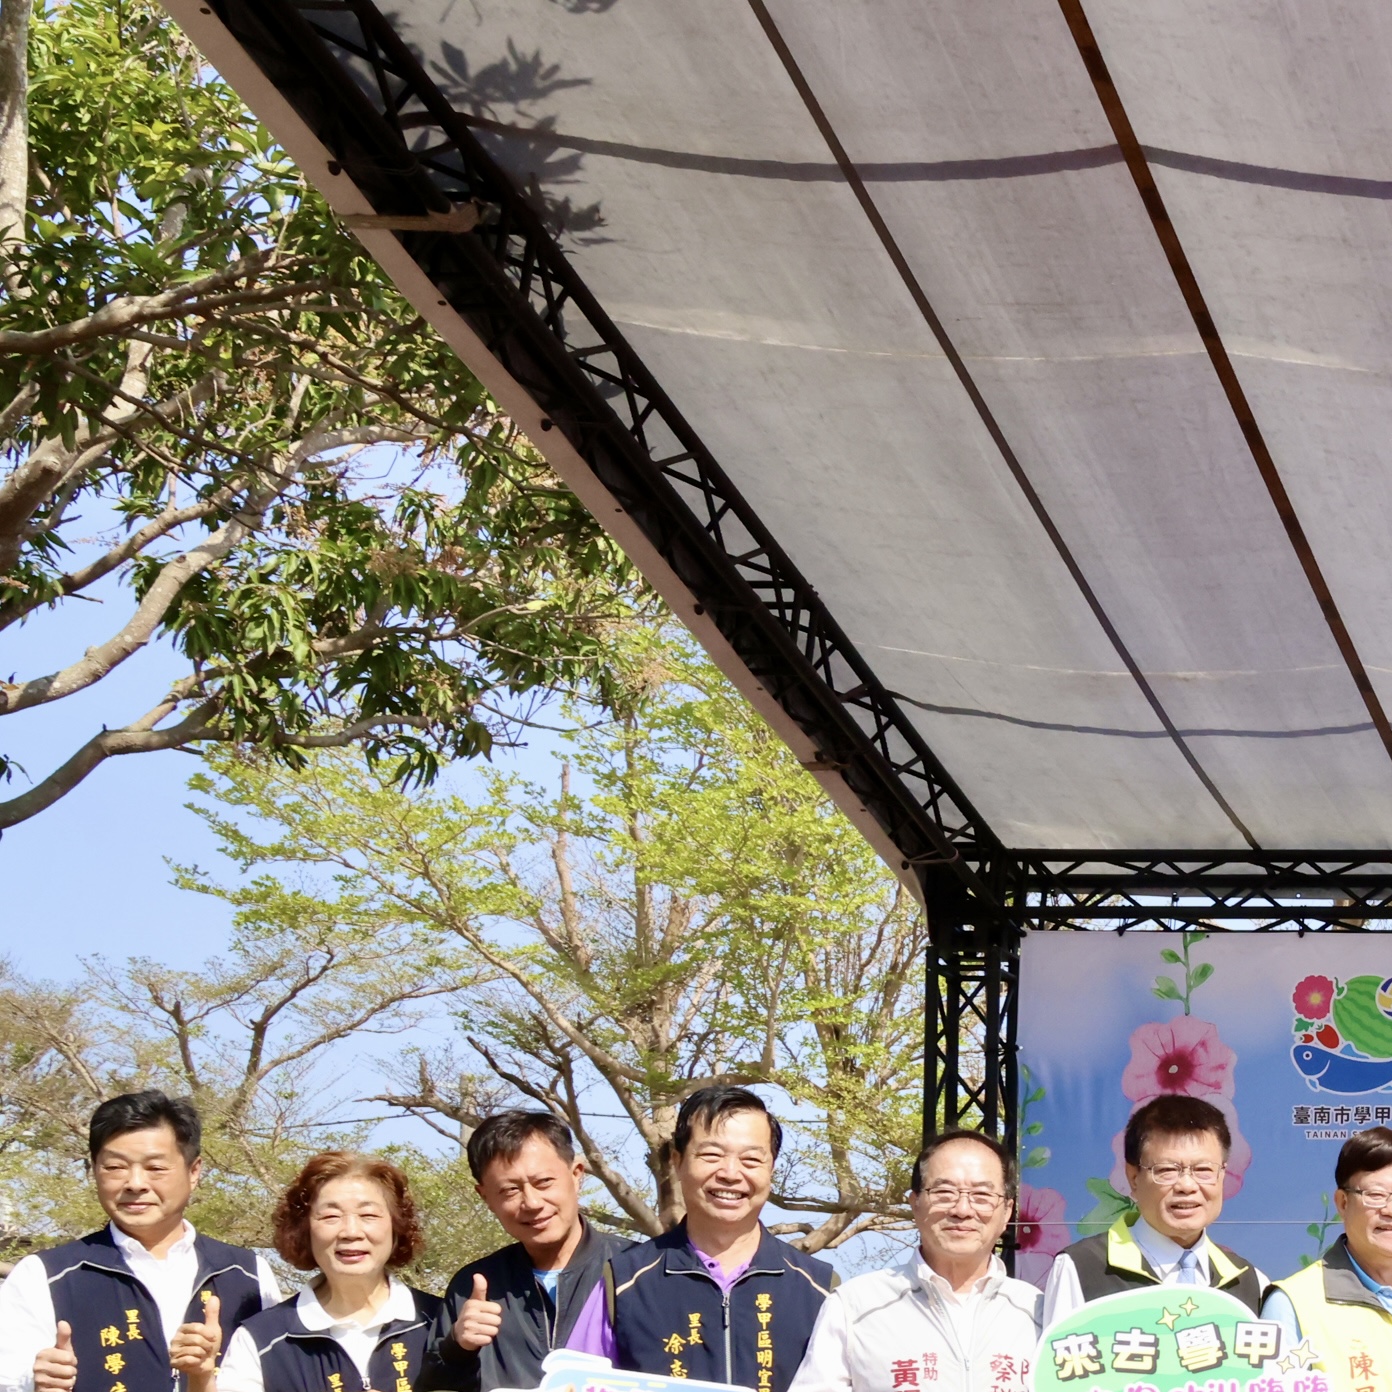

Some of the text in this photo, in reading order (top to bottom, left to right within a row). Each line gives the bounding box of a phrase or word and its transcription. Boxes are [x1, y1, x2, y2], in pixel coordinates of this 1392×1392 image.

[1306, 1131, 1347, 1139] TAINAN
[125, 1309, 143, 1340] 里長
[687, 1313, 703, 1345] 里長
[922, 1352, 938, 1381] 特助
[1051, 1321, 1281, 1381] 來去學甲
